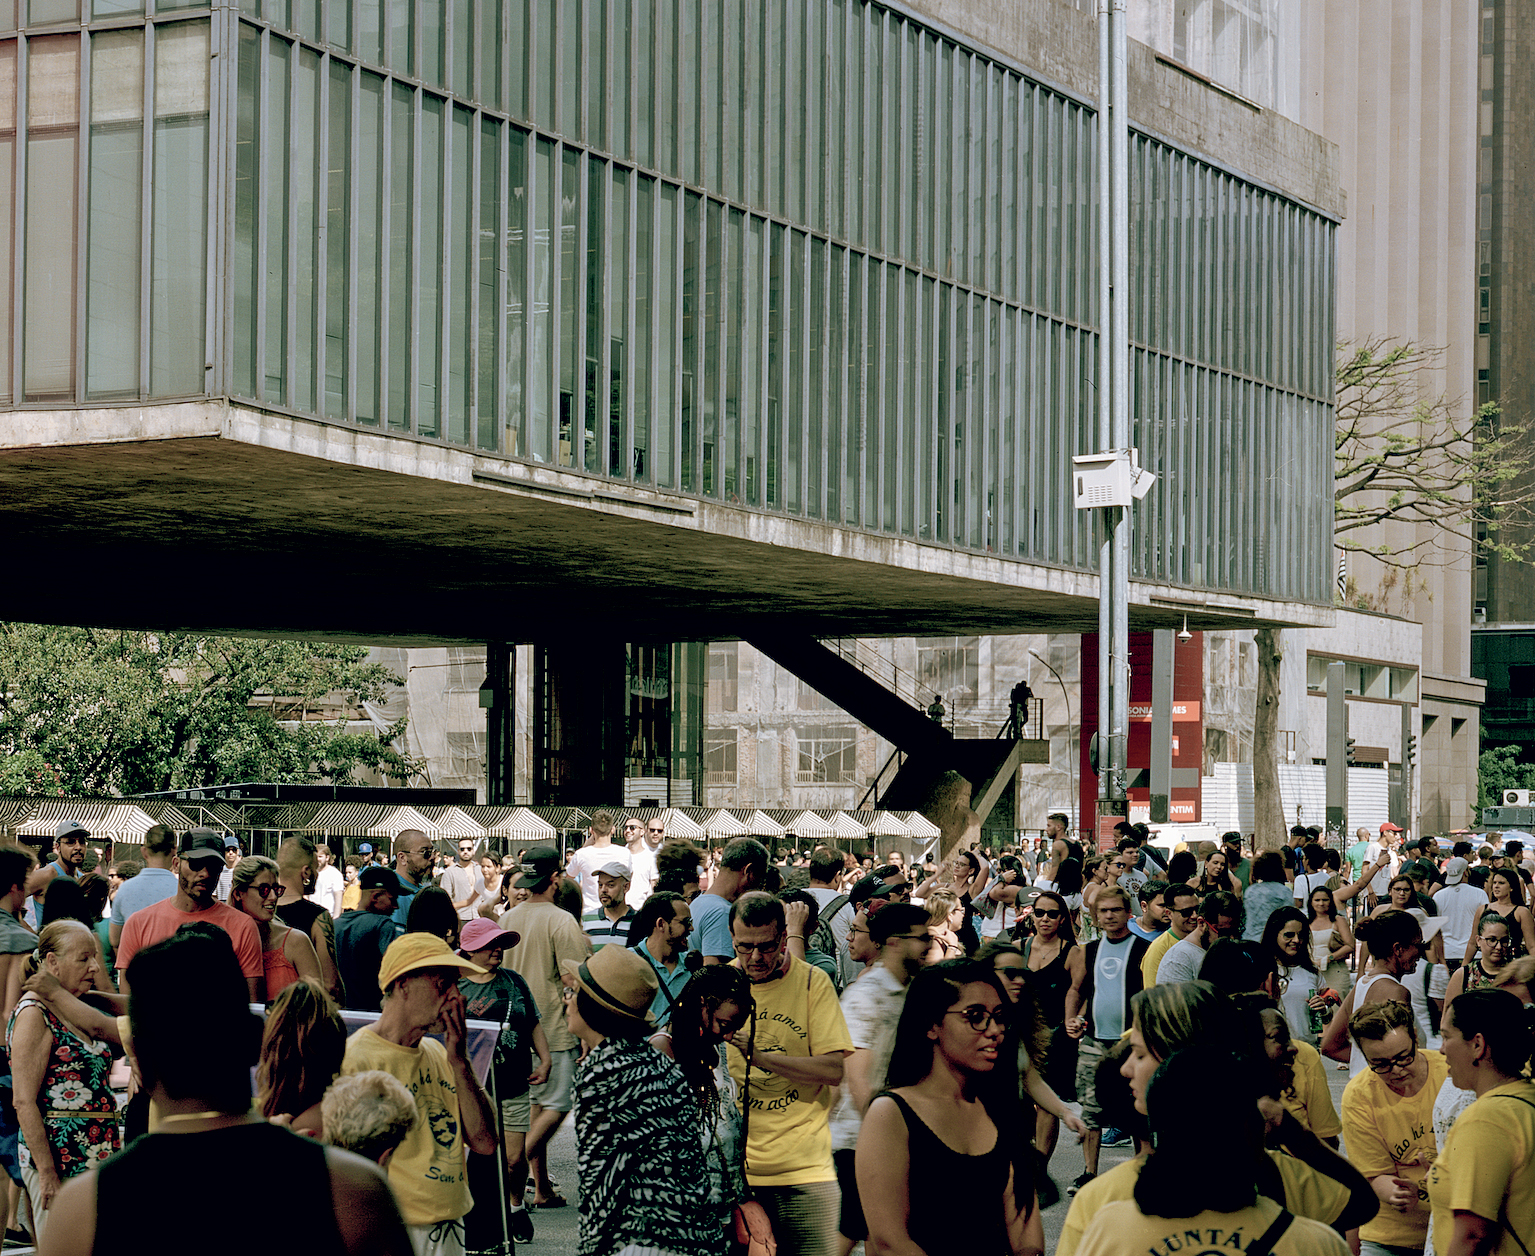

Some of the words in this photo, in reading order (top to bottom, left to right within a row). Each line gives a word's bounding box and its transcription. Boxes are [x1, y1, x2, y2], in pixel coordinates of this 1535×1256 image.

[771, 1012, 808, 1040] amor
[766, 1088, 800, 1113] ação
[424, 1165, 455, 1184] Sem
